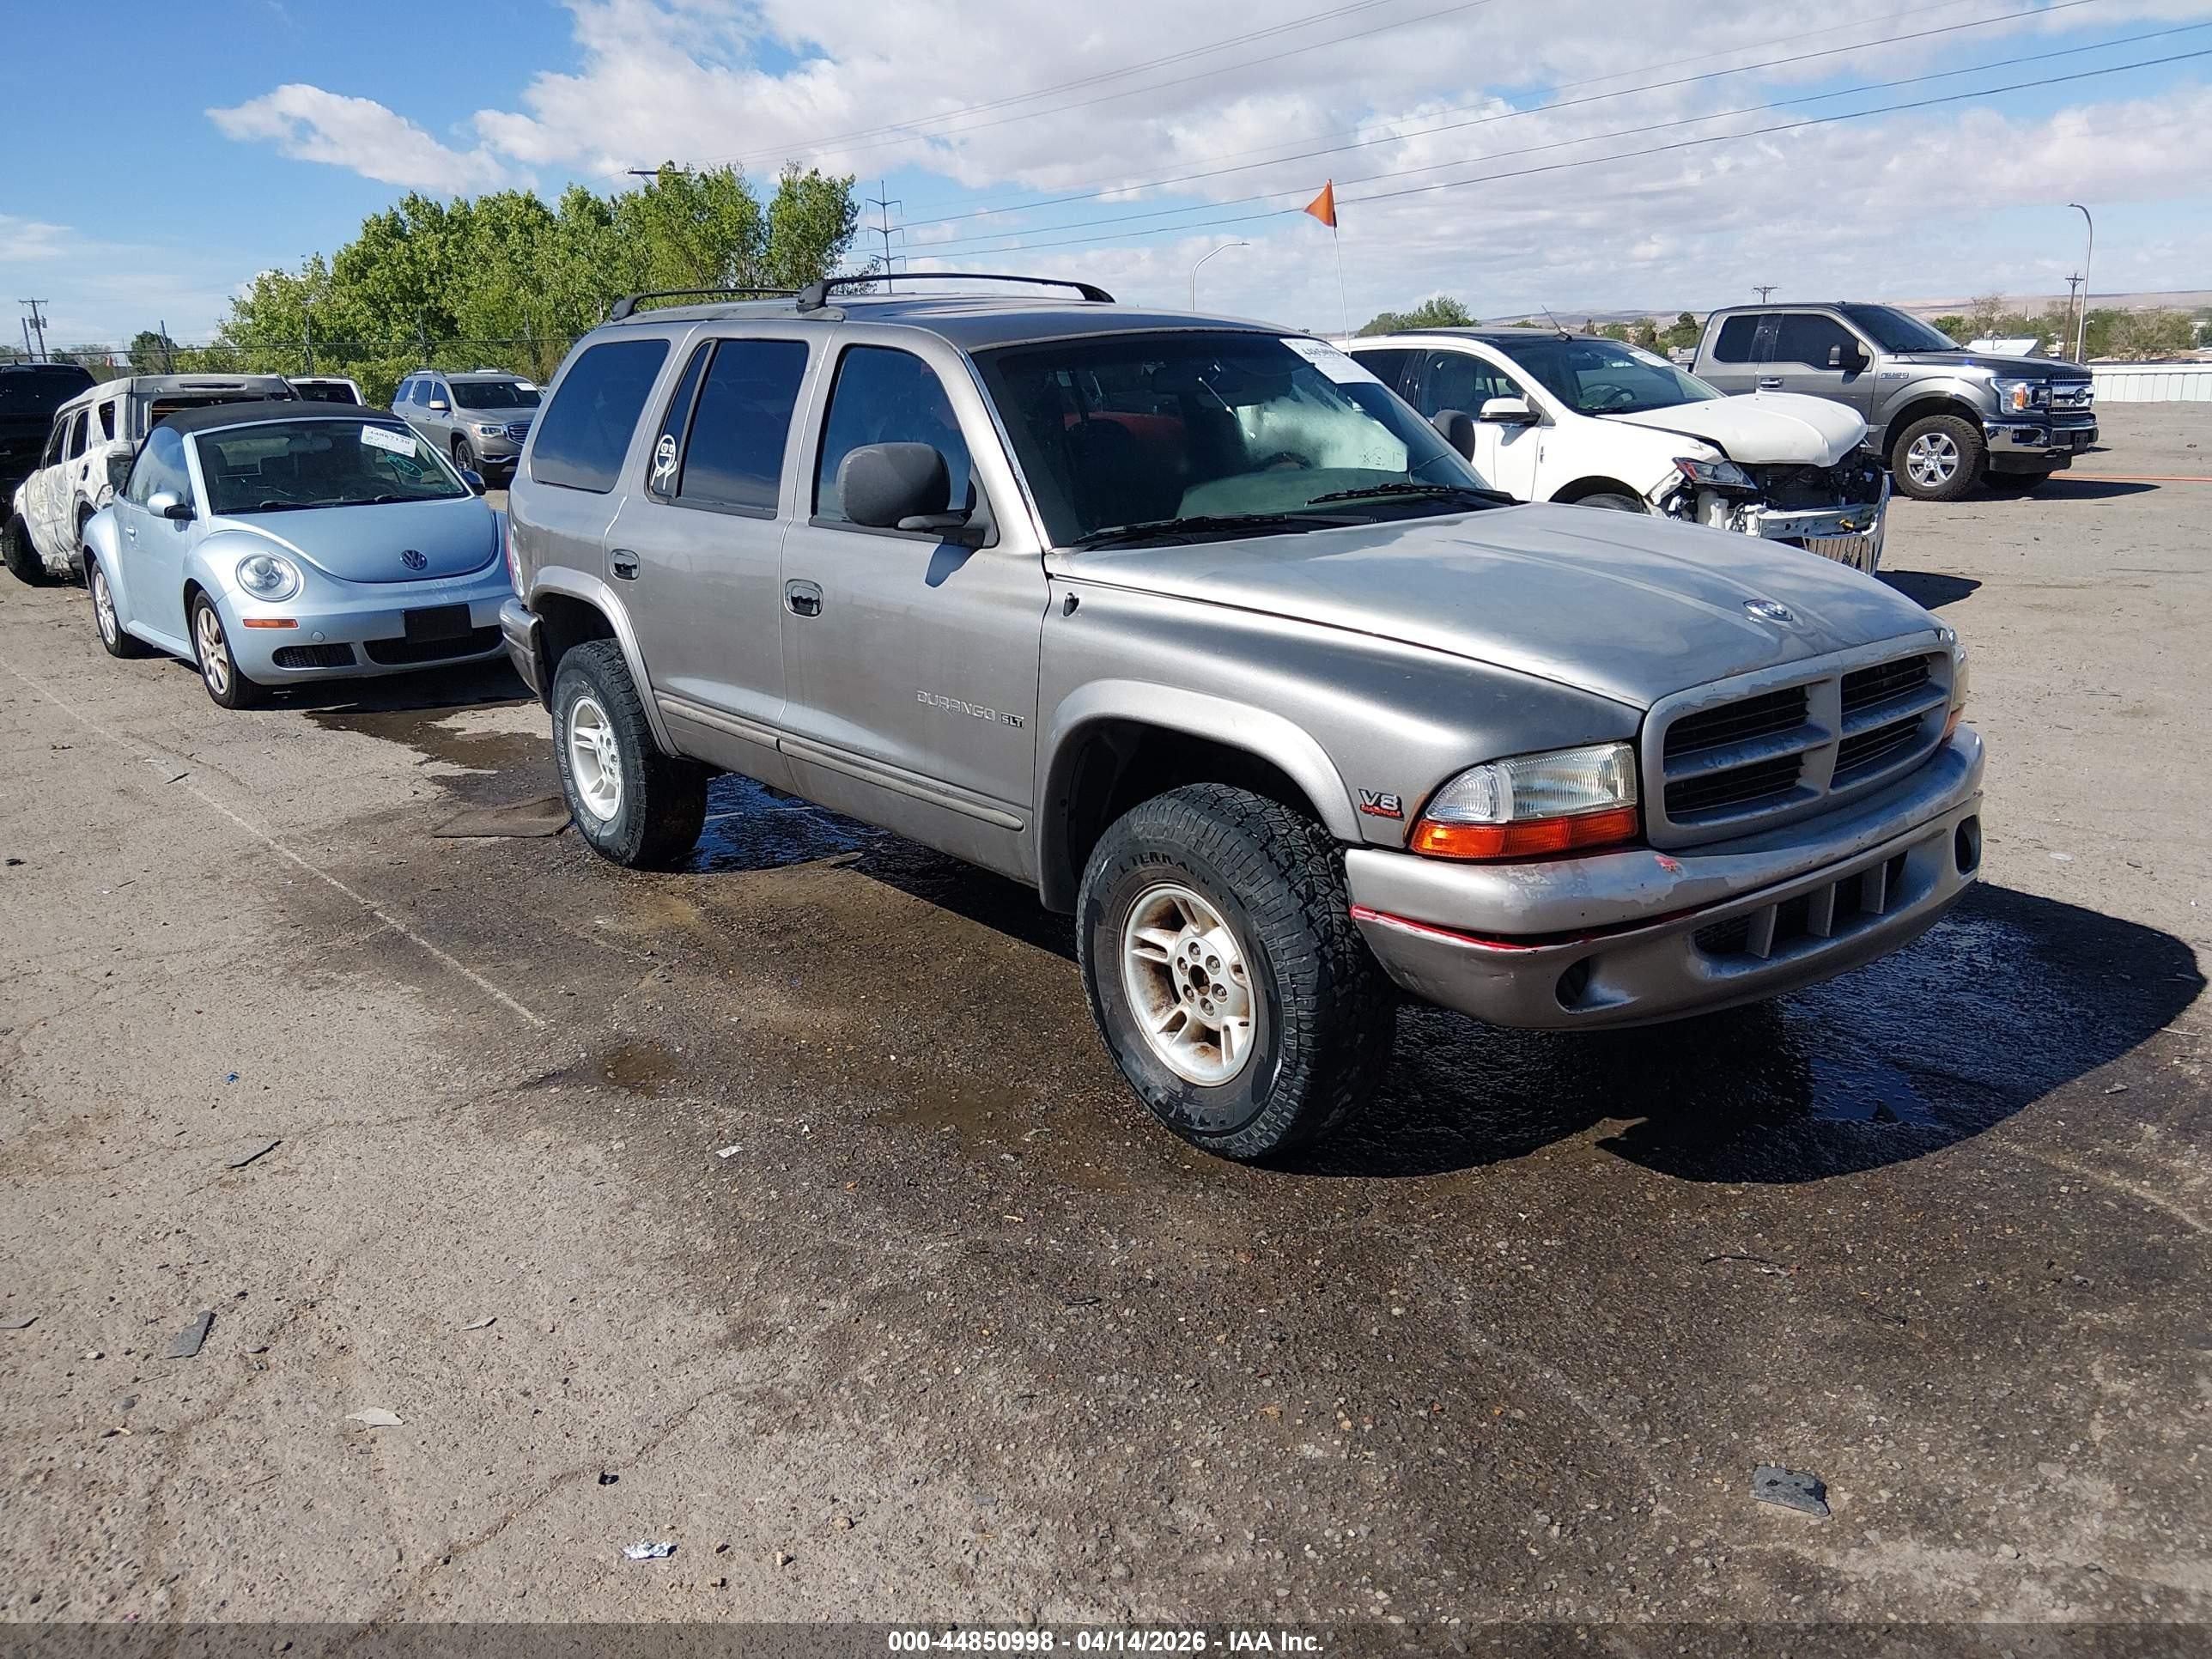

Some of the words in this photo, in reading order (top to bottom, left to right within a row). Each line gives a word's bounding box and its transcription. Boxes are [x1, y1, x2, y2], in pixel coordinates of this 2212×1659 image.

[916, 690, 996, 722] DURANGO
[1001, 714, 1023, 728] SLT
[1358, 789, 1399, 811] V8
[1361, 805, 1402, 818] MAGNUM
